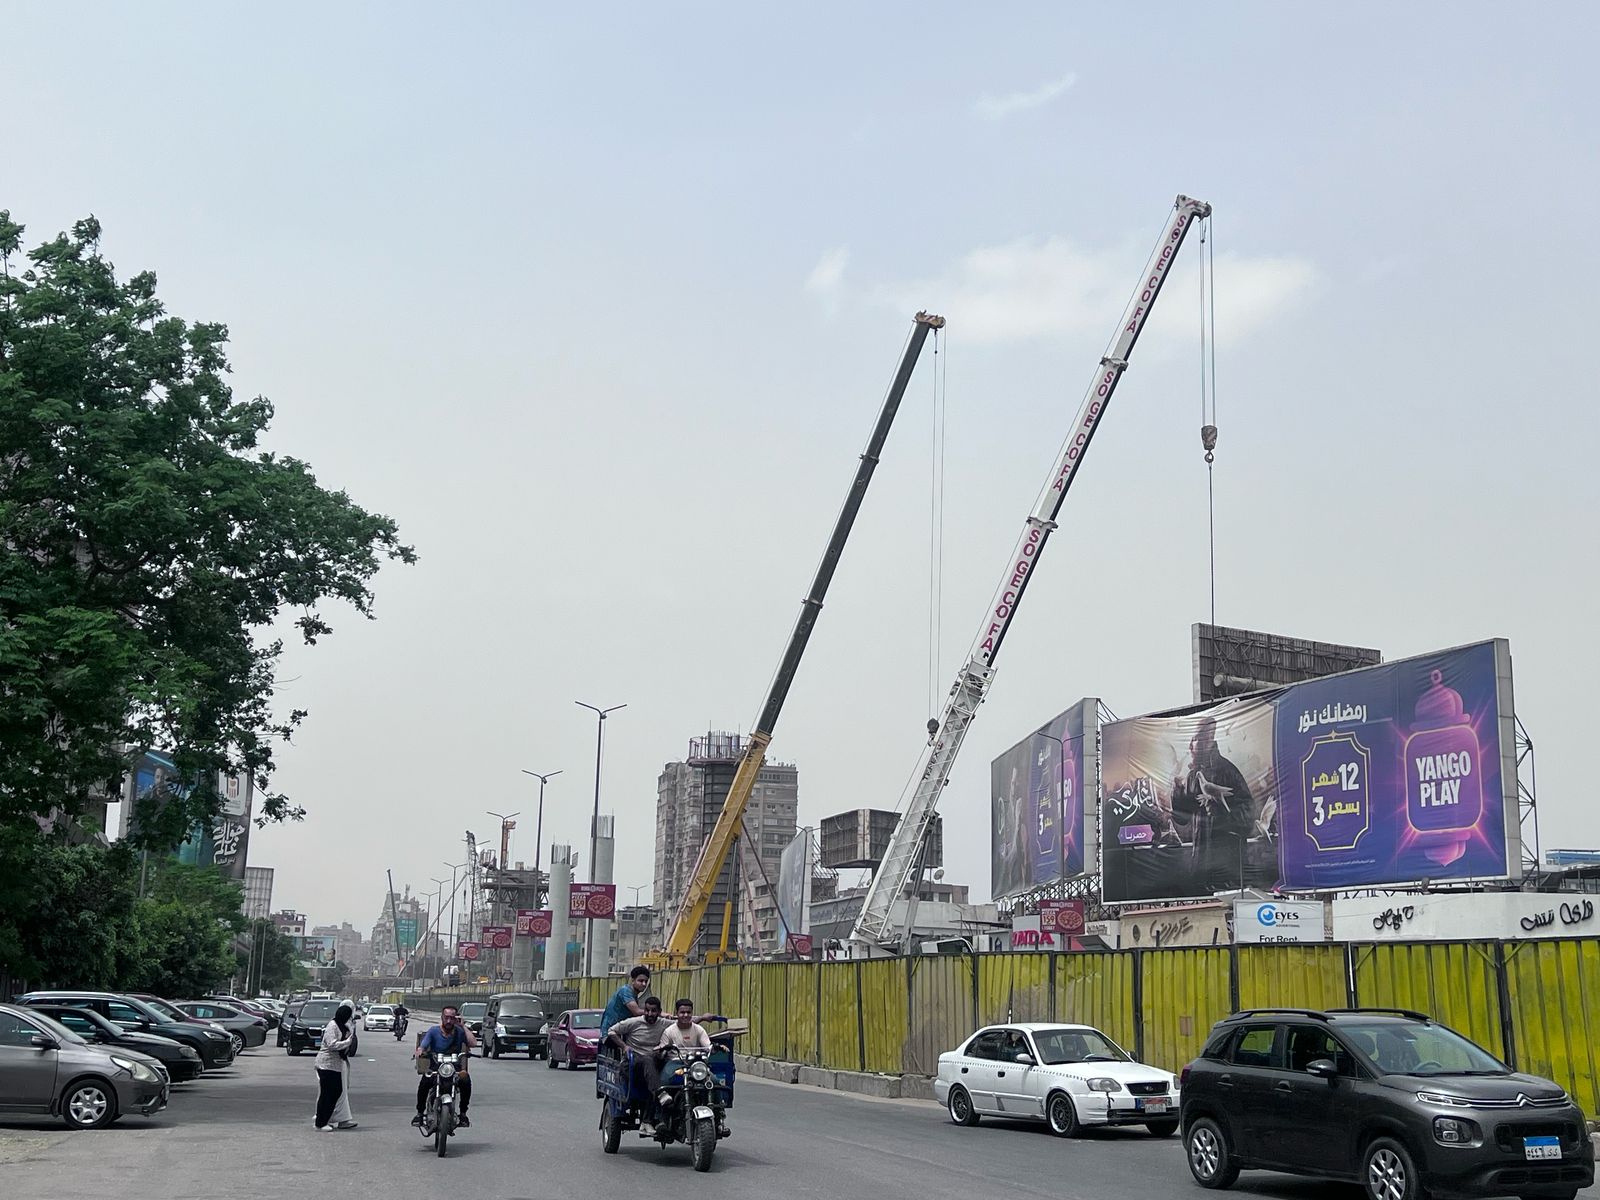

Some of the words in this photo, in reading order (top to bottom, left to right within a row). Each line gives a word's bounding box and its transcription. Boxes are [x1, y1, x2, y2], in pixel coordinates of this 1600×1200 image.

[1318, 702, 1367, 723] رمضانك
[1338, 762, 1360, 791] 12
[1415, 751, 1471, 782] YANGO
[1312, 770, 1339, 791] شهر
[1420, 779, 1461, 808] PLAY
[1312, 796, 1325, 826] 3
[1328, 801, 1360, 820] بسعر
[573, 900, 585, 908] 159
[1043, 915, 1055, 924] 159
[1260, 935, 1275, 943] For
[1277, 935, 1298, 943] Rent
